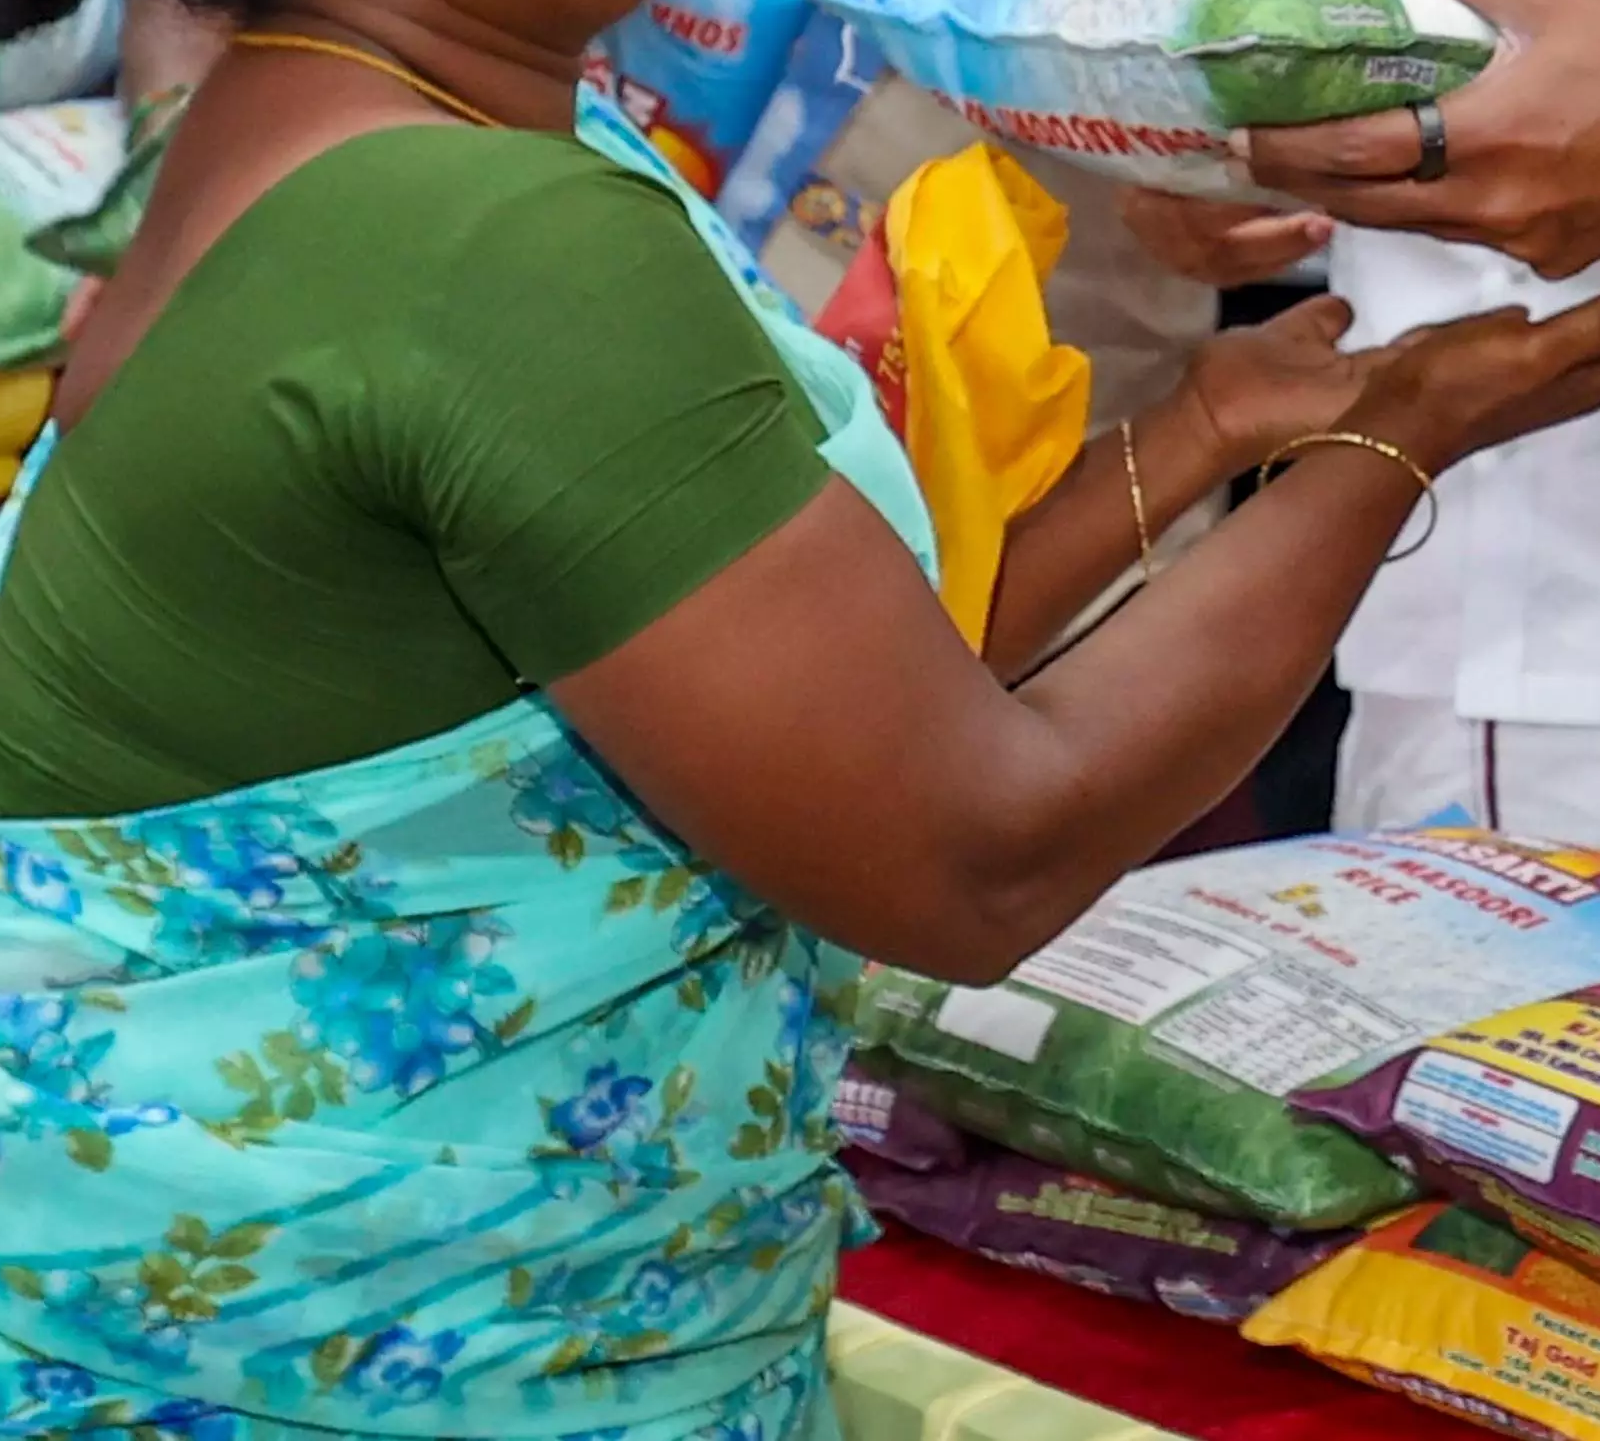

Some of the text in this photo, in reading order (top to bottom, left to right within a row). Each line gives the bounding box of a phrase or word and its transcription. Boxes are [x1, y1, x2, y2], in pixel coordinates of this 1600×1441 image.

[1335, 867, 1421, 906] RICE
[1387, 859, 1551, 930] MASOORI
[1504, 1325, 1542, 1360] Taj
[1545, 1343, 1599, 1378] Gold
